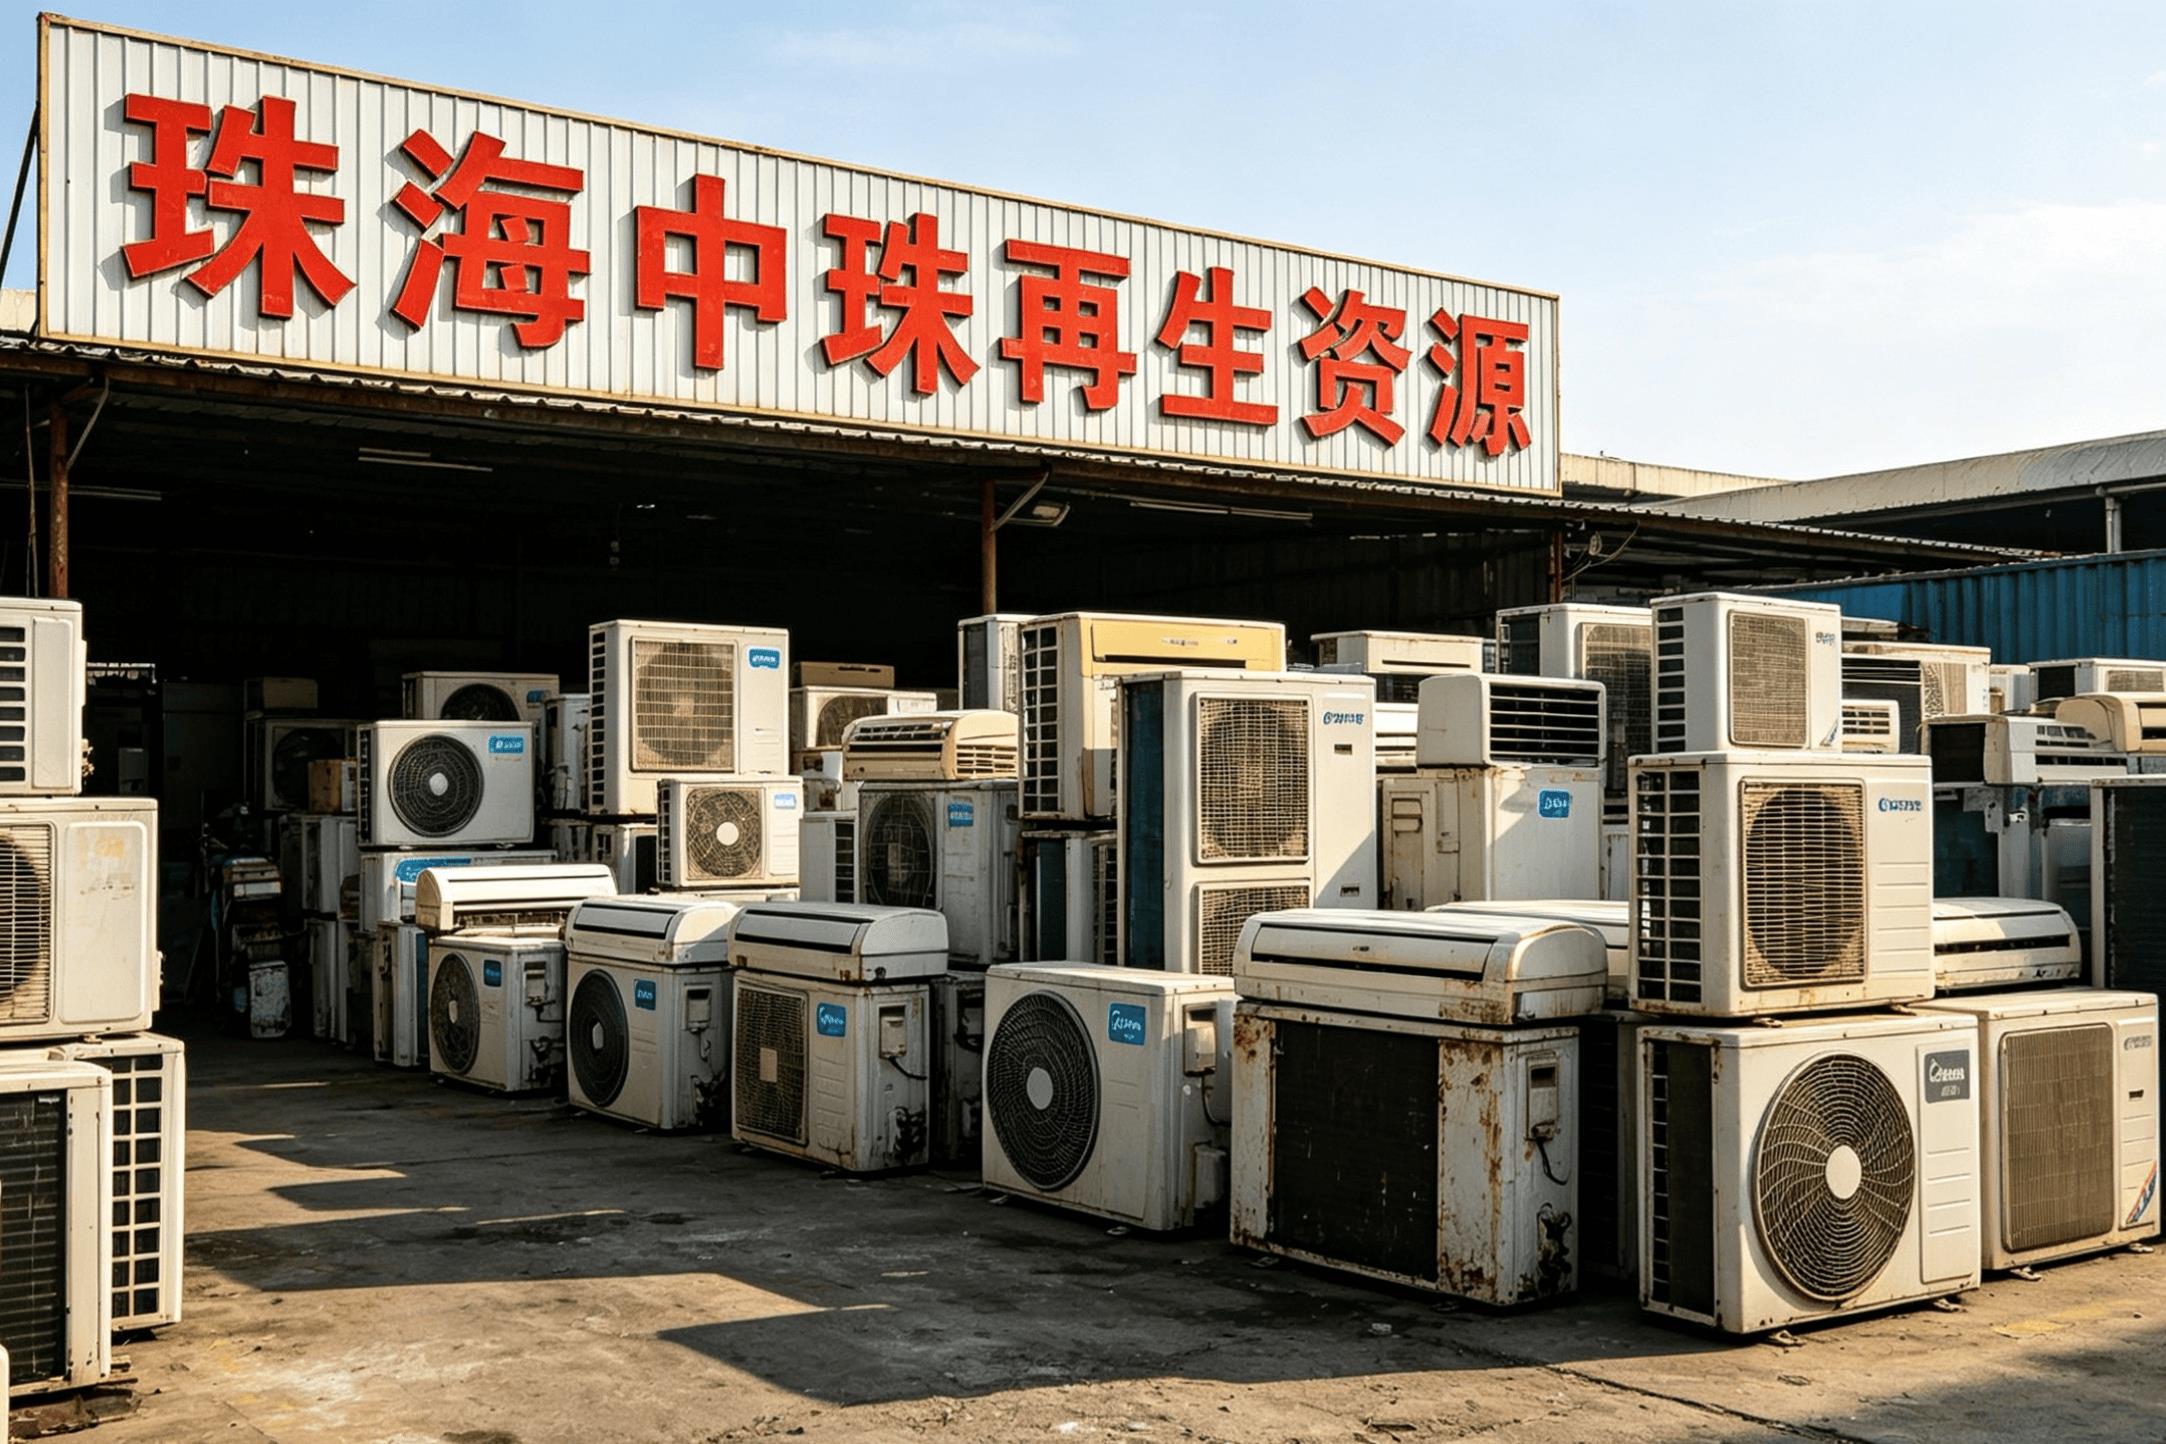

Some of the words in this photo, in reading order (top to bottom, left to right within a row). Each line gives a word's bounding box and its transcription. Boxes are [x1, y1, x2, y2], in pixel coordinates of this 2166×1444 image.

[123, 93, 1531, 458] 珠海中珠再生资源
